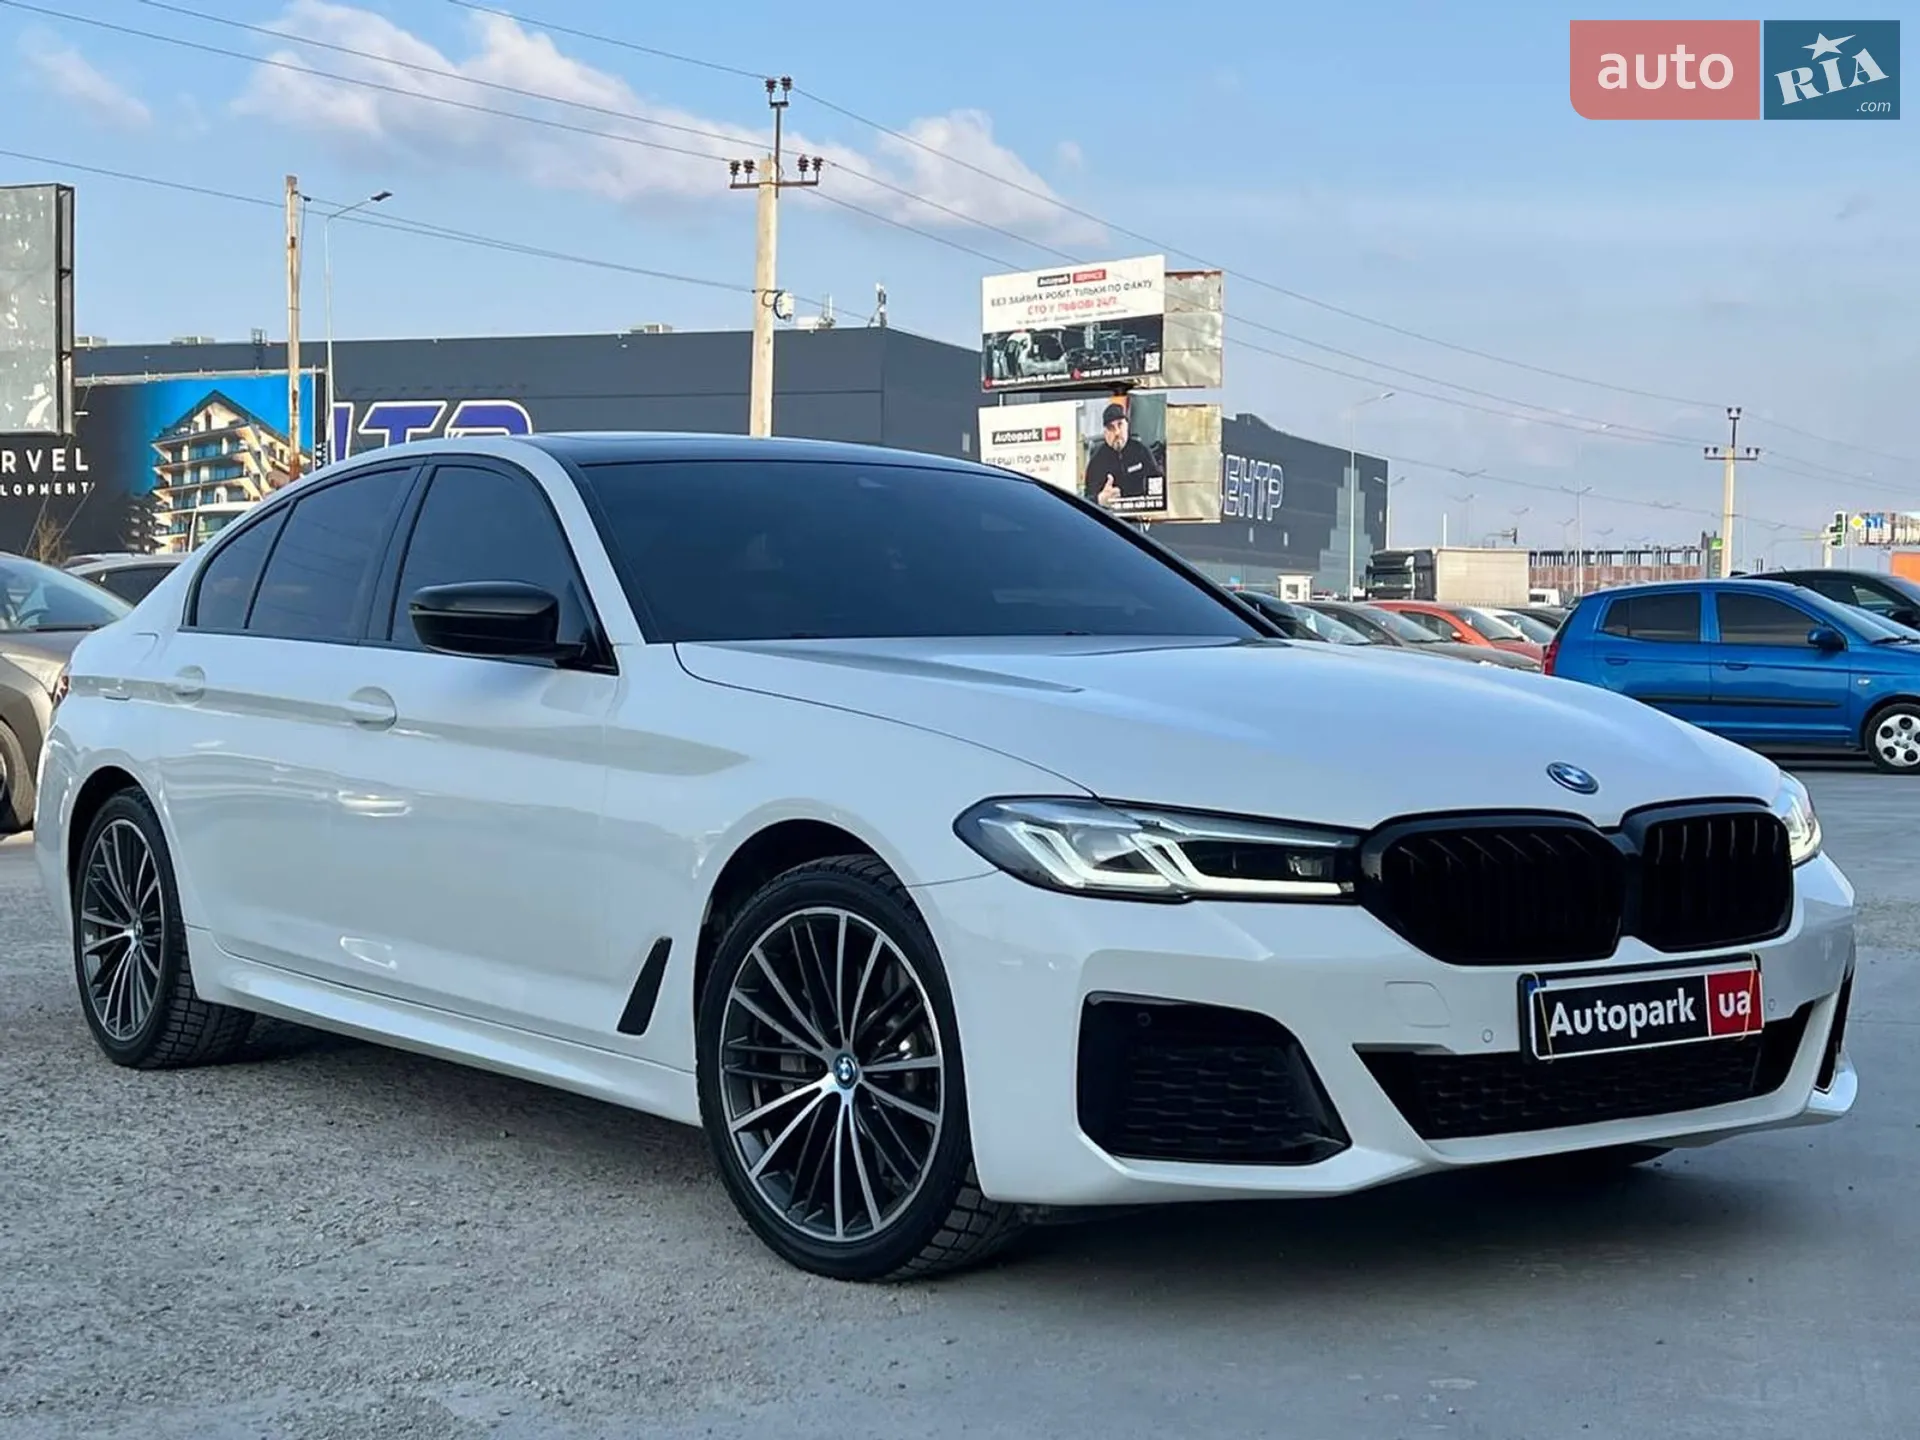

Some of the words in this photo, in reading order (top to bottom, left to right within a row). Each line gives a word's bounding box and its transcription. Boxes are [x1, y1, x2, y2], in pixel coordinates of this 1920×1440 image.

[994, 428, 1041, 443] Autopark
[1, 447, 89, 474] RVEL
[1219, 452, 1284, 522] ЕНТР
[1549, 987, 1698, 1039] Autopark
[1717, 990, 1752, 1018] ua
